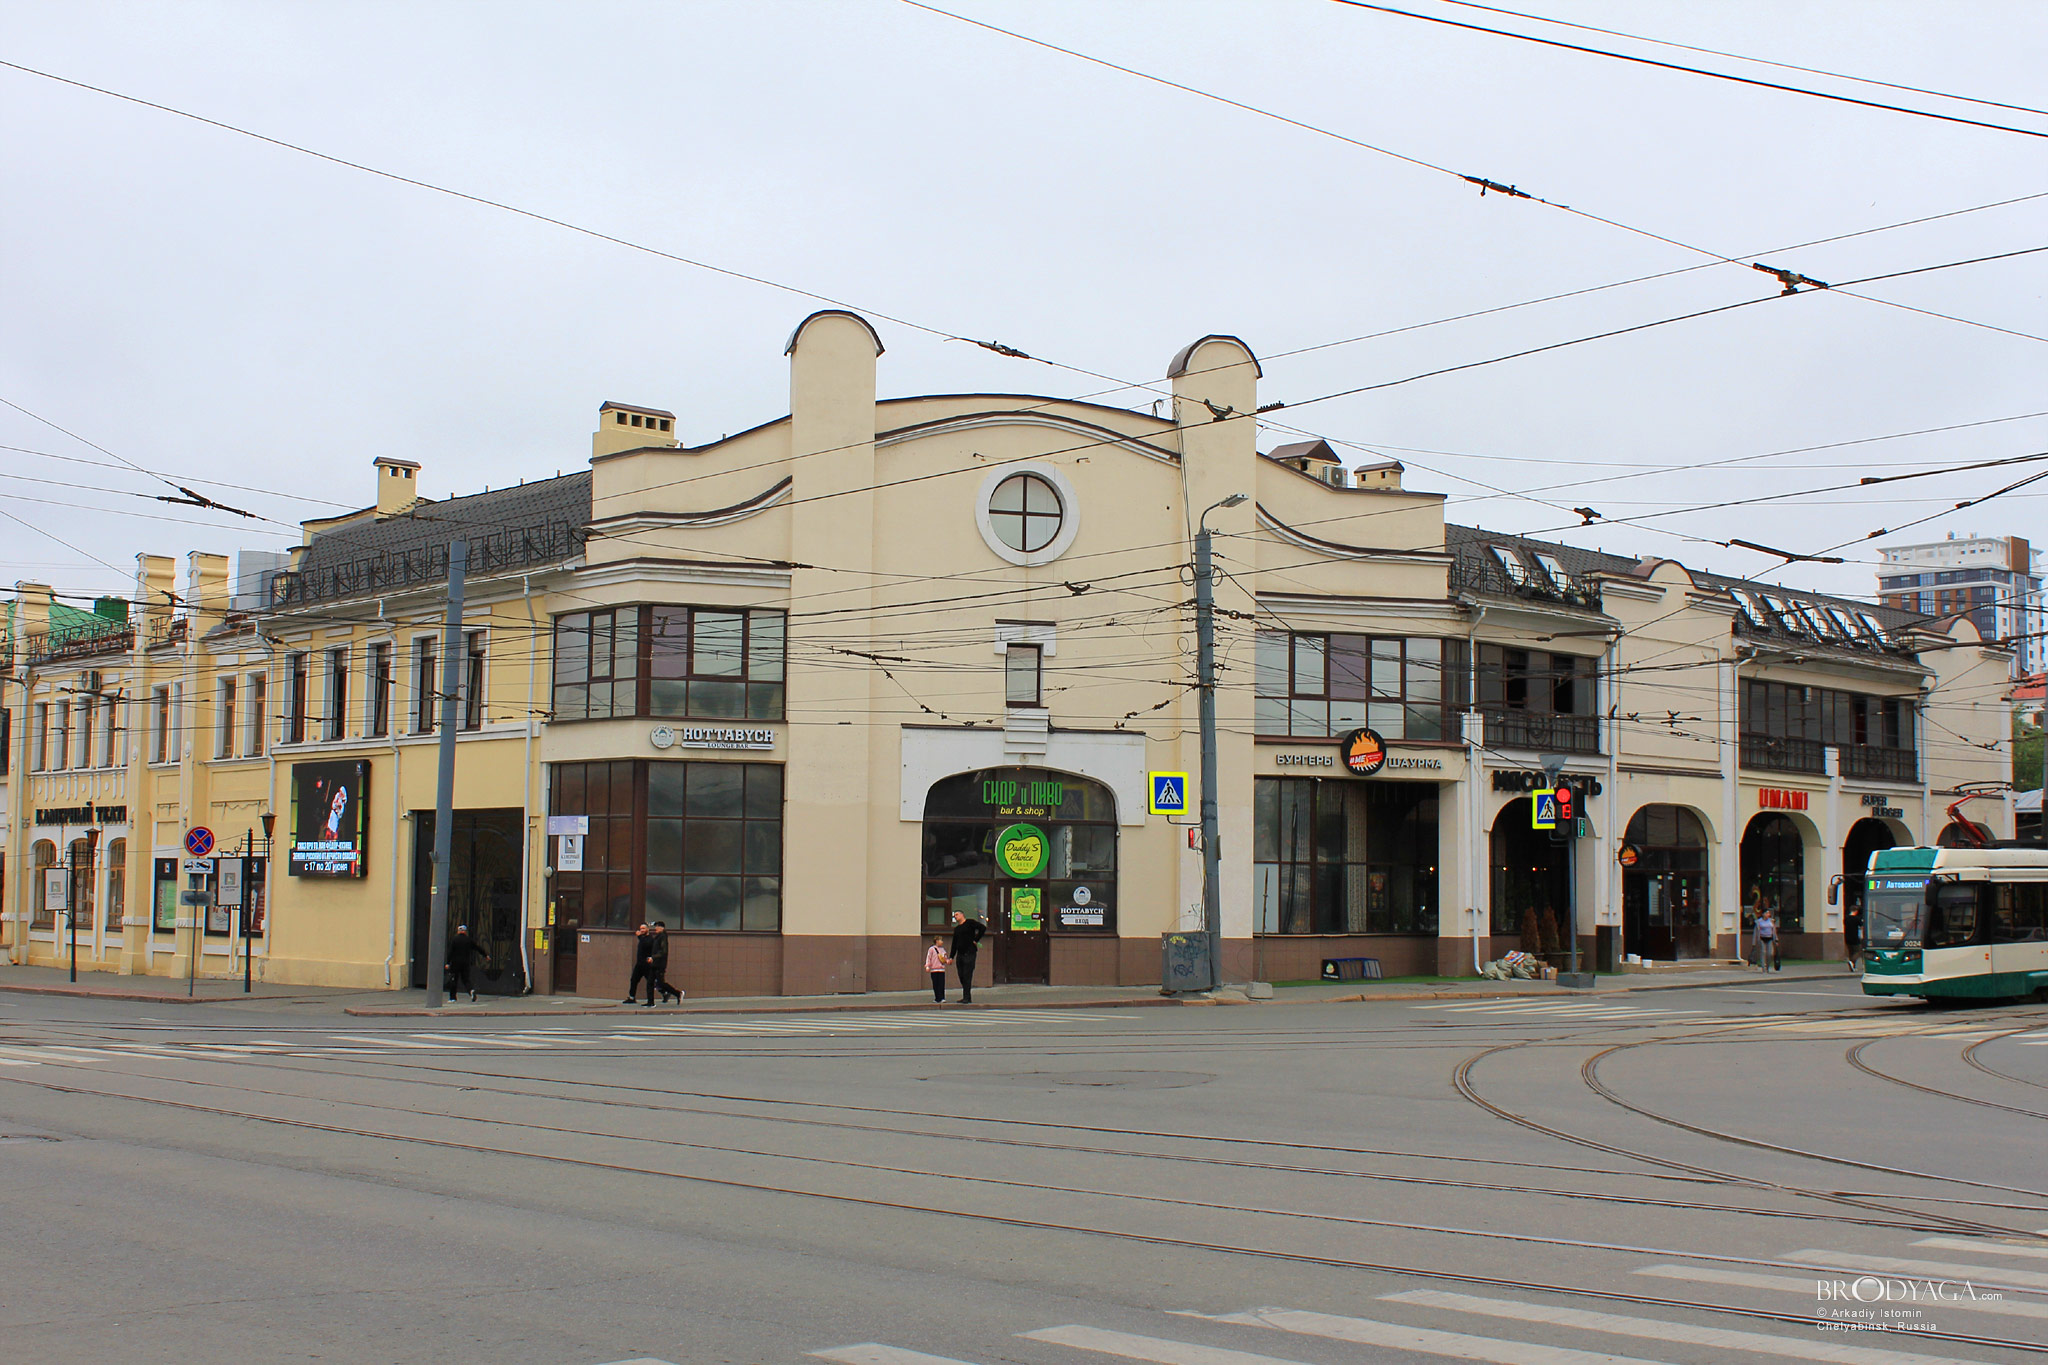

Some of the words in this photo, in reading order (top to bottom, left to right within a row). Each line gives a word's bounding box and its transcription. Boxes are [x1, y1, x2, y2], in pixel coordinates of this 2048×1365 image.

[682, 727, 774, 742] HOTTABYCH
[1276, 754, 1334, 767] БУРГЕРЫ
[1387, 757, 1443, 769] ШАУРМА
[1492, 770, 1547, 792] МЯСО
[983, 780, 1017, 805] СИДР
[1021, 787, 1027, 805] и
[1031, 781, 1063, 806] ПИВО
[1759, 788, 1808, 810] UMAMI
[1861, 794, 1888, 807] SUPER
[1000, 806, 1014, 815] bar
[1016, 806, 1022, 815] &
[1024, 806, 1044, 817] shop
[1872, 806, 1903, 818] BURGER
[1010, 852, 1034, 861] Choice
[309, 861, 316, 871] 17
[316, 863, 324, 871] по
[324, 861, 332, 871] 20
[1886, 880, 1923, 889] Автовокзал
